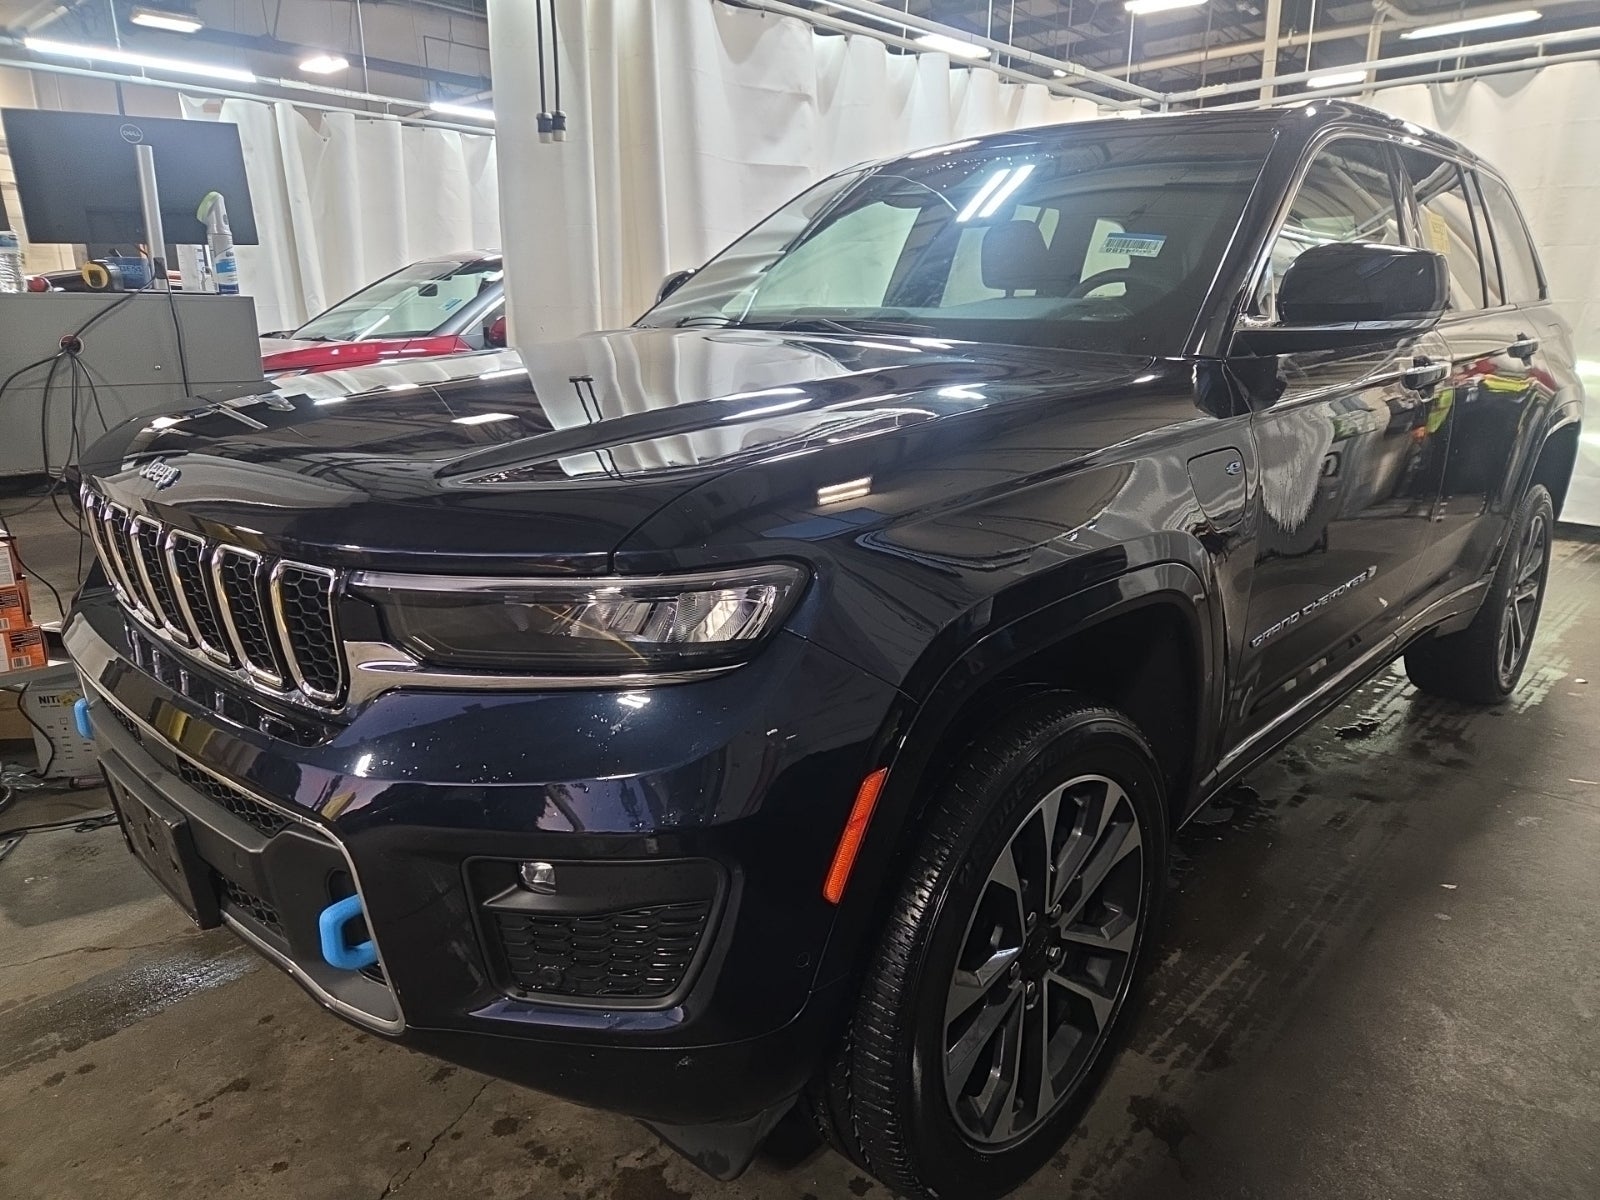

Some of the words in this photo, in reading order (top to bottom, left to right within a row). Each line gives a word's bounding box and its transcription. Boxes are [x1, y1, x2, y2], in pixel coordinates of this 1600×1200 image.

[139, 456, 180, 489] Jeep
[1251, 611, 1300, 648] GRAND
[1302, 571, 1368, 616] CHEROKEE
